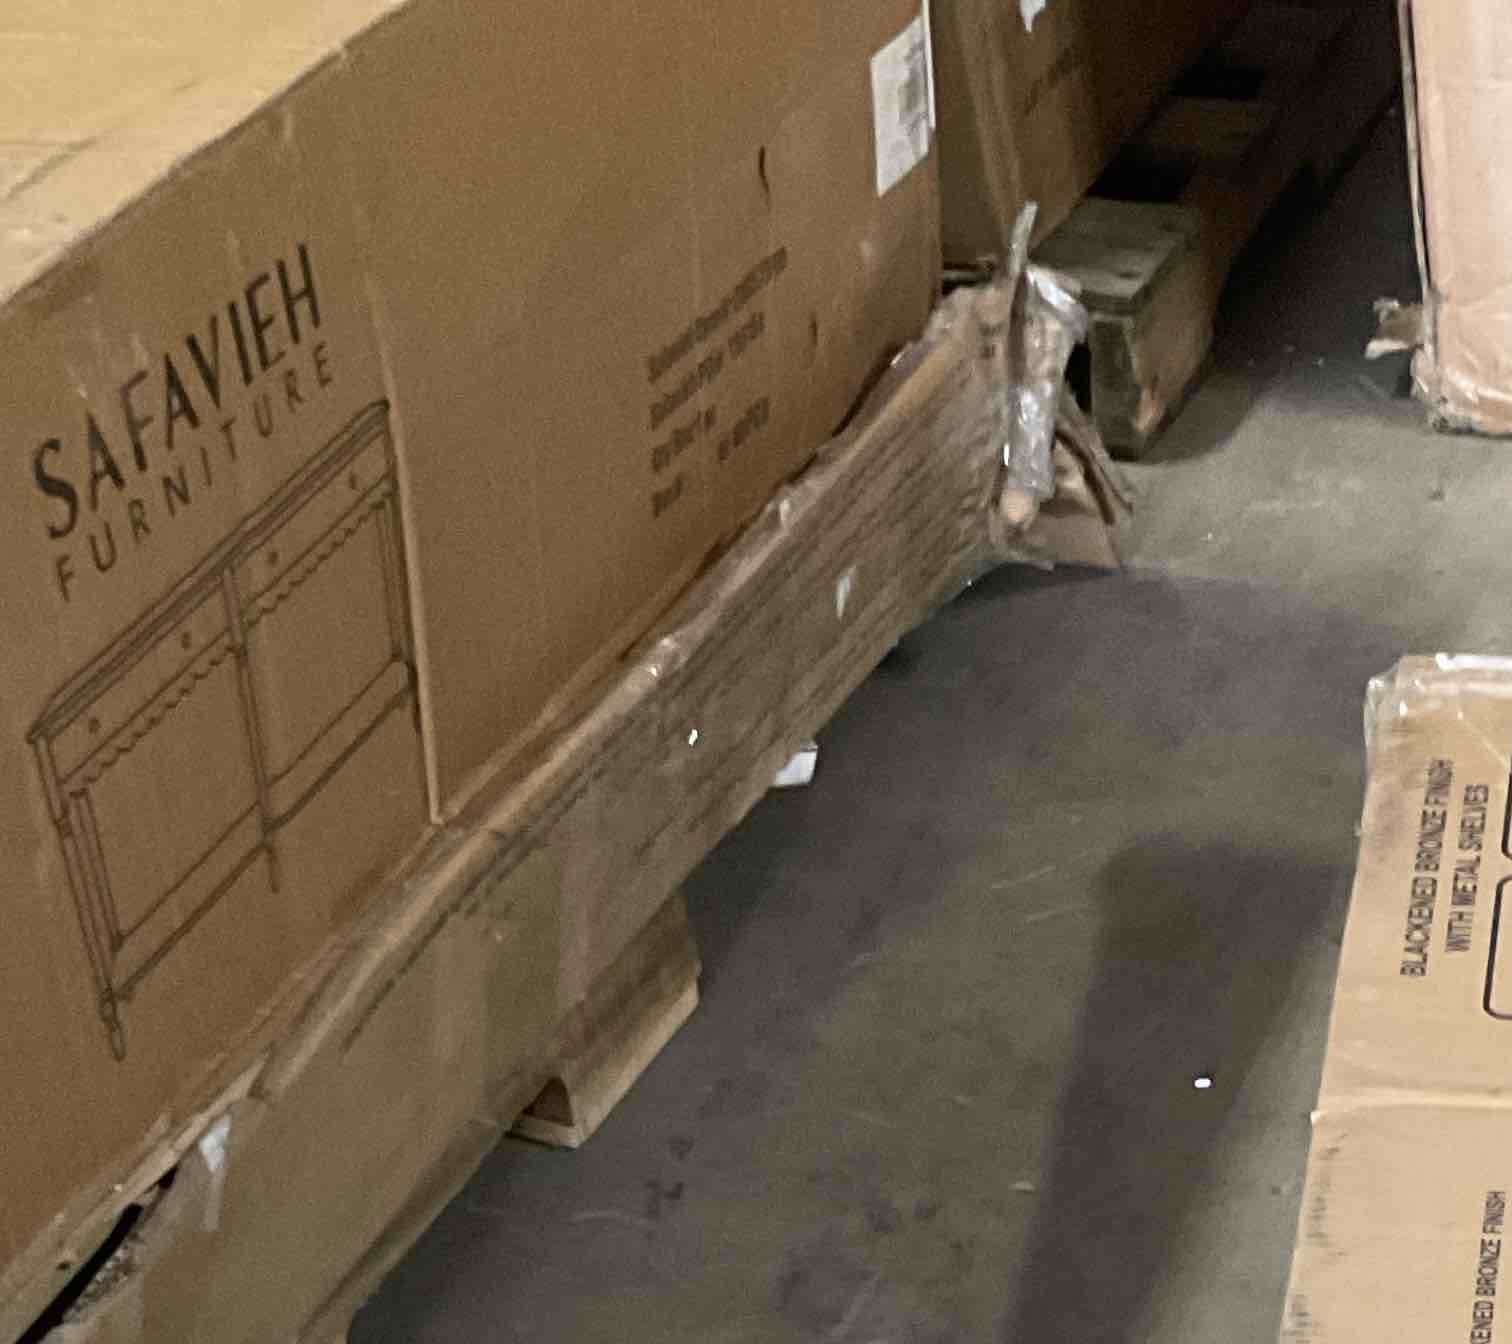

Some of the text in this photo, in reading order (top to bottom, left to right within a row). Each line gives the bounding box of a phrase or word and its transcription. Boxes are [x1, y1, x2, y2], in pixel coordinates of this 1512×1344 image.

[33, 243, 321, 540] SAFAVIEH
[55, 341, 332, 602] FURNITURE
[1414, 811, 1447, 872] BRONZE
[1445, 784, 1488, 952] WITH METAL SHELVES
[1400, 877, 1437, 977] BLACKENED
[1482, 1191, 1506, 1235] FINISH
[1475, 1239, 1501, 1297] BRONZE
